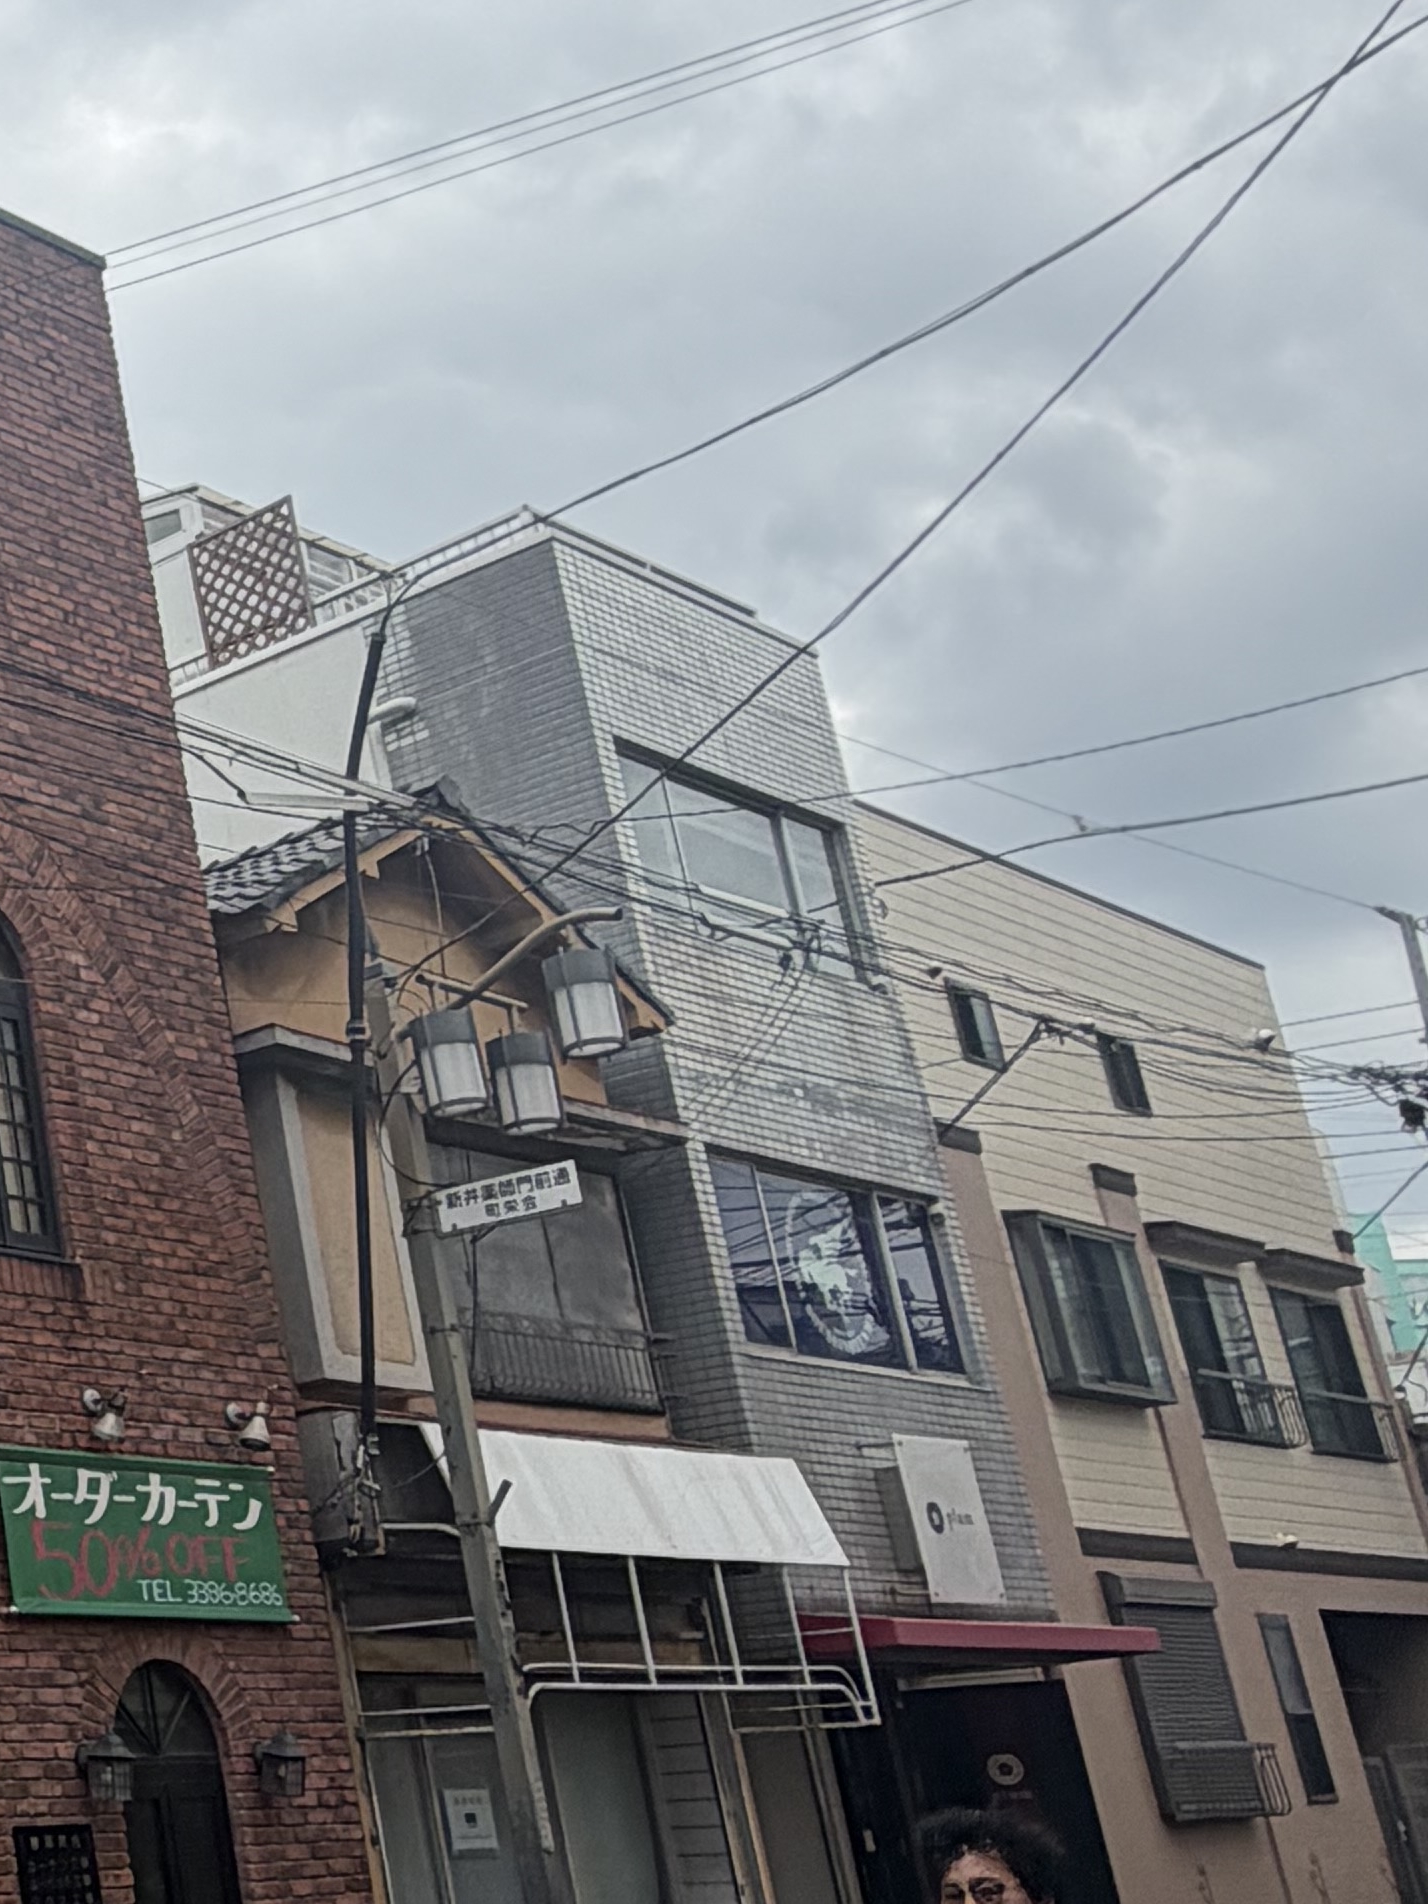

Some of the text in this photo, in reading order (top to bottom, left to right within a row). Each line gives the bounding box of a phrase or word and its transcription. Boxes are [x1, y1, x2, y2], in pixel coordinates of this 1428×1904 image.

[1, 1462, 263, 1530] オーダーカーテン
[136, 1578, 183, 1603] TEL
